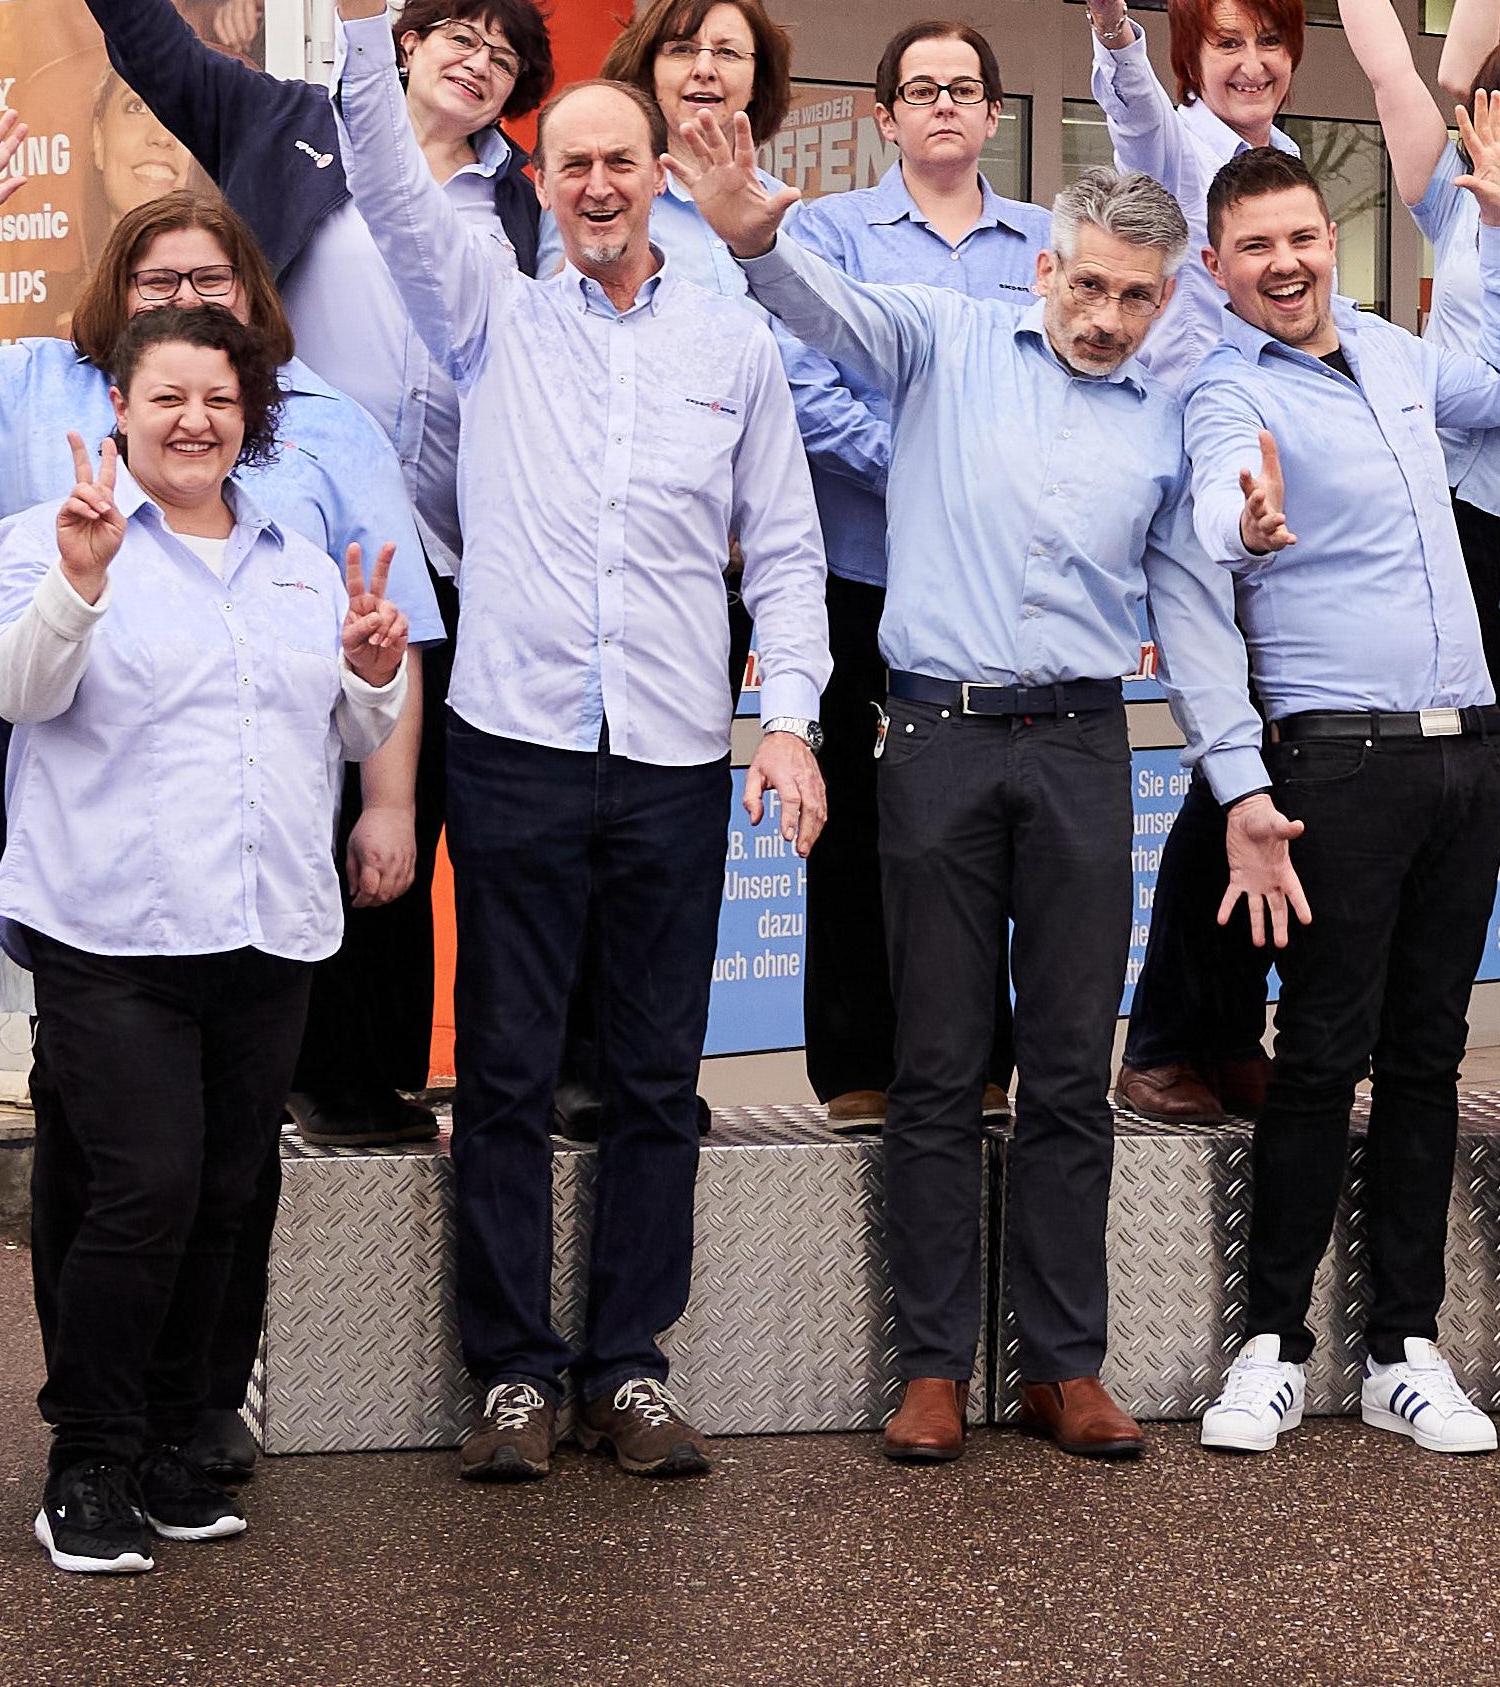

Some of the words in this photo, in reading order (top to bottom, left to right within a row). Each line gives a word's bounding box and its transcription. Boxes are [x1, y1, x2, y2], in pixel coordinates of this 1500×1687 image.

[802, 95, 854, 125] WIEDER
[1137, 770, 1165, 799] Sie
[724, 870, 791, 902] Unsere
[757, 908, 803, 939] dazu
[713, 950, 747, 983] uch
[752, 948, 800, 980] ohne
